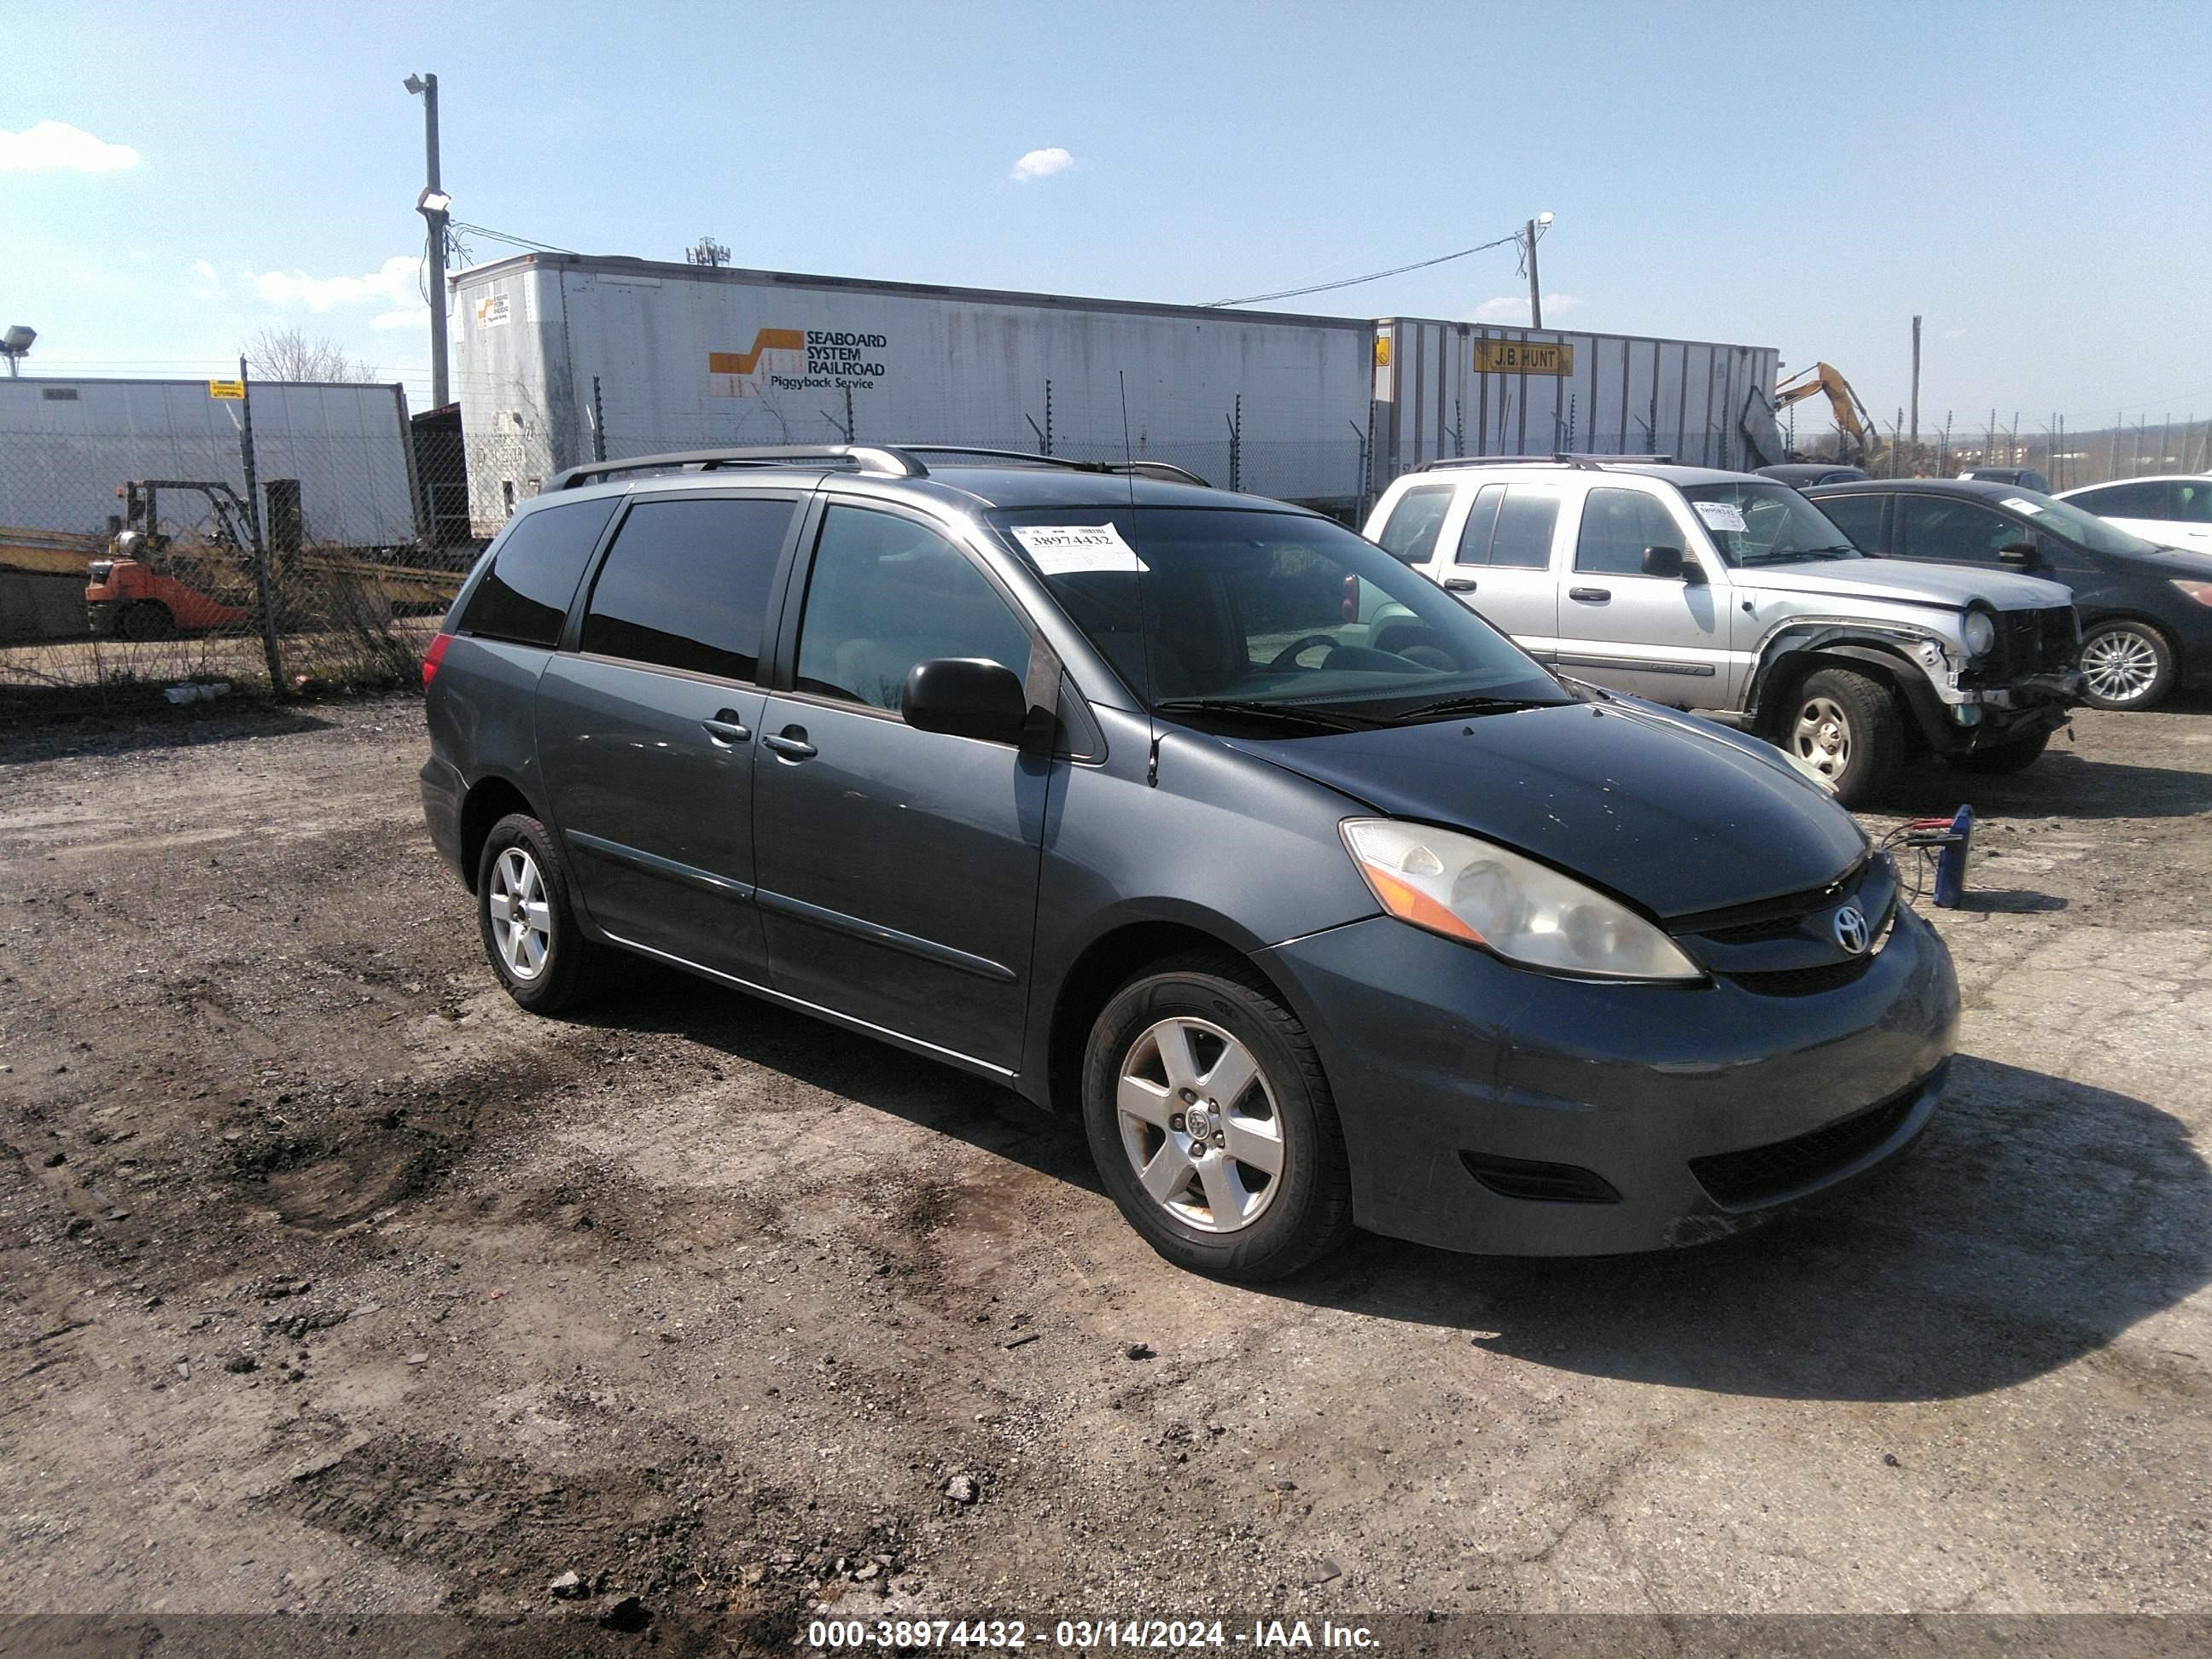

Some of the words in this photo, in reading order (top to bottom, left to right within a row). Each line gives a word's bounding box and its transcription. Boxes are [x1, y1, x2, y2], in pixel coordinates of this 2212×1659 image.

[806, 331, 887, 348] SEABOARD
[806, 346, 860, 361] SYSTEM
[1495, 348, 1518, 365] J.B.
[1522, 349, 1555, 367] HUNT
[807, 361, 885, 376] RAILROAD
[771, 375, 831, 390] Piggyback
[835, 377, 875, 389] Service
[1030, 536, 1114, 546] 38974432
